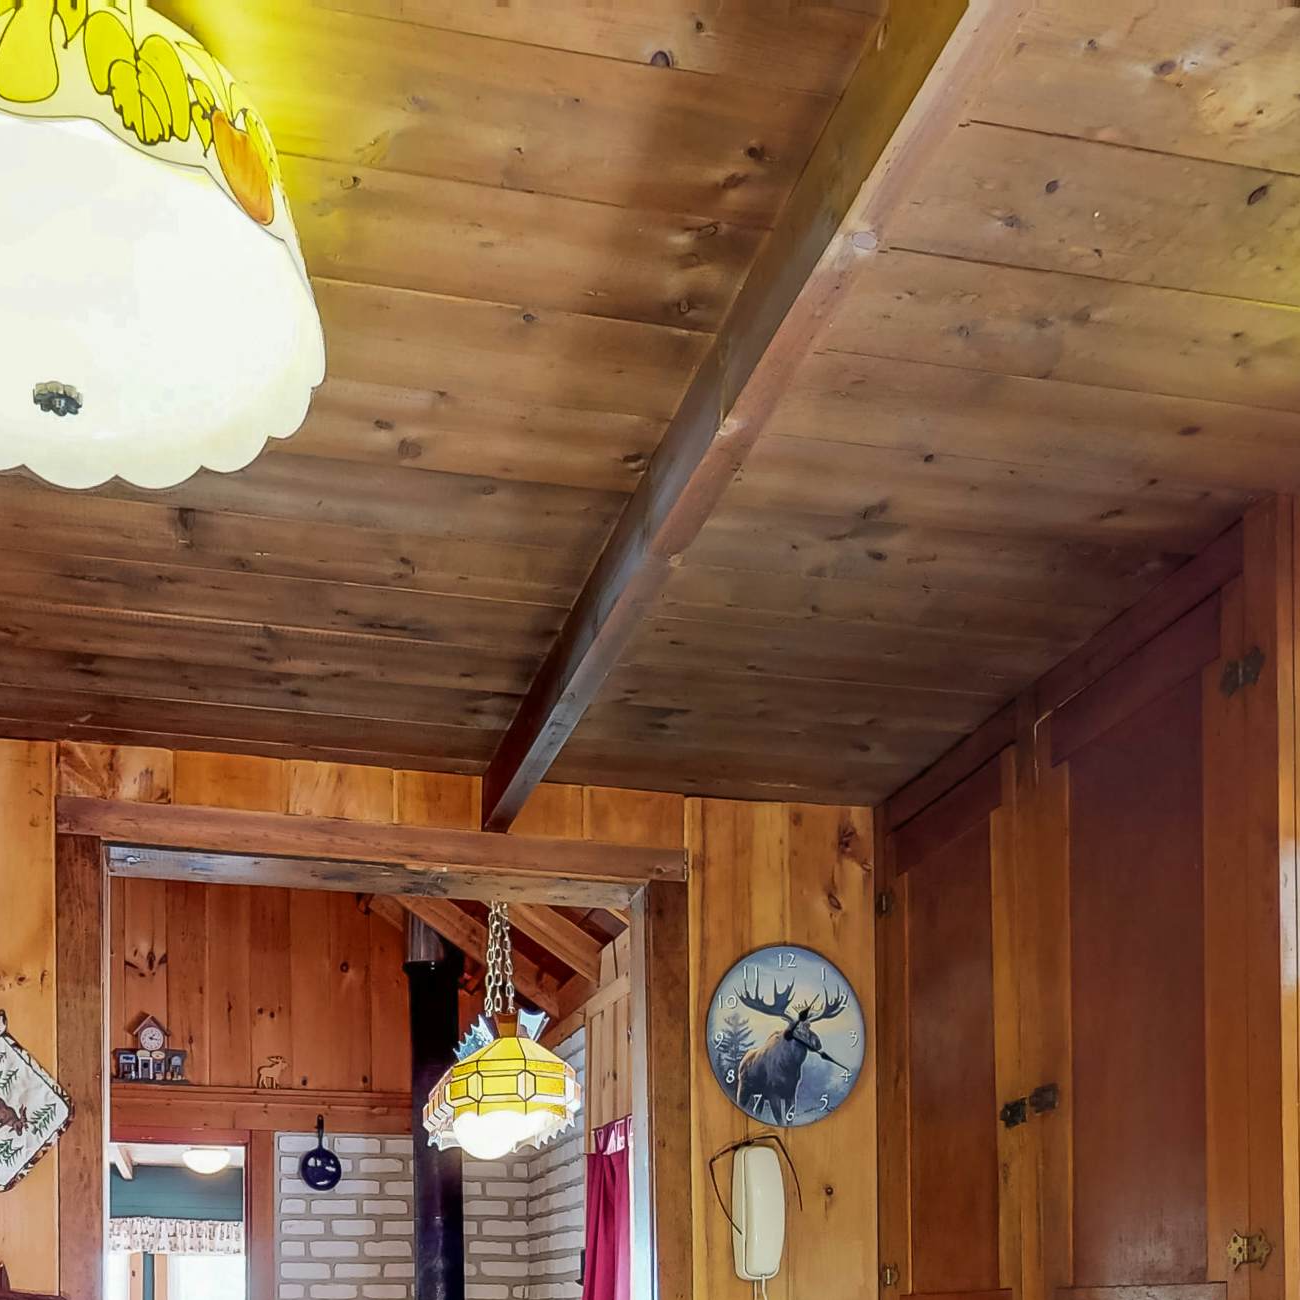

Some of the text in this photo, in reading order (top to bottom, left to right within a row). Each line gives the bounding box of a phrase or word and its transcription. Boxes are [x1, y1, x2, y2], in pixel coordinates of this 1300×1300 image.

[778, 953, 796, 968] 12
[743, 966, 759, 980] 11
[718, 995, 737, 1009] 10
[839, 993, 849, 1008] 2
[714, 1032, 724, 1049] 9
[850, 1032, 859, 1047] 3
[725, 1069, 735, 1083] 8
[840, 1069, 852, 1082] 4
[753, 1095, 762, 1111] 7
[820, 1094, 828, 1110] 5
[785, 1104, 795, 1121] 6
